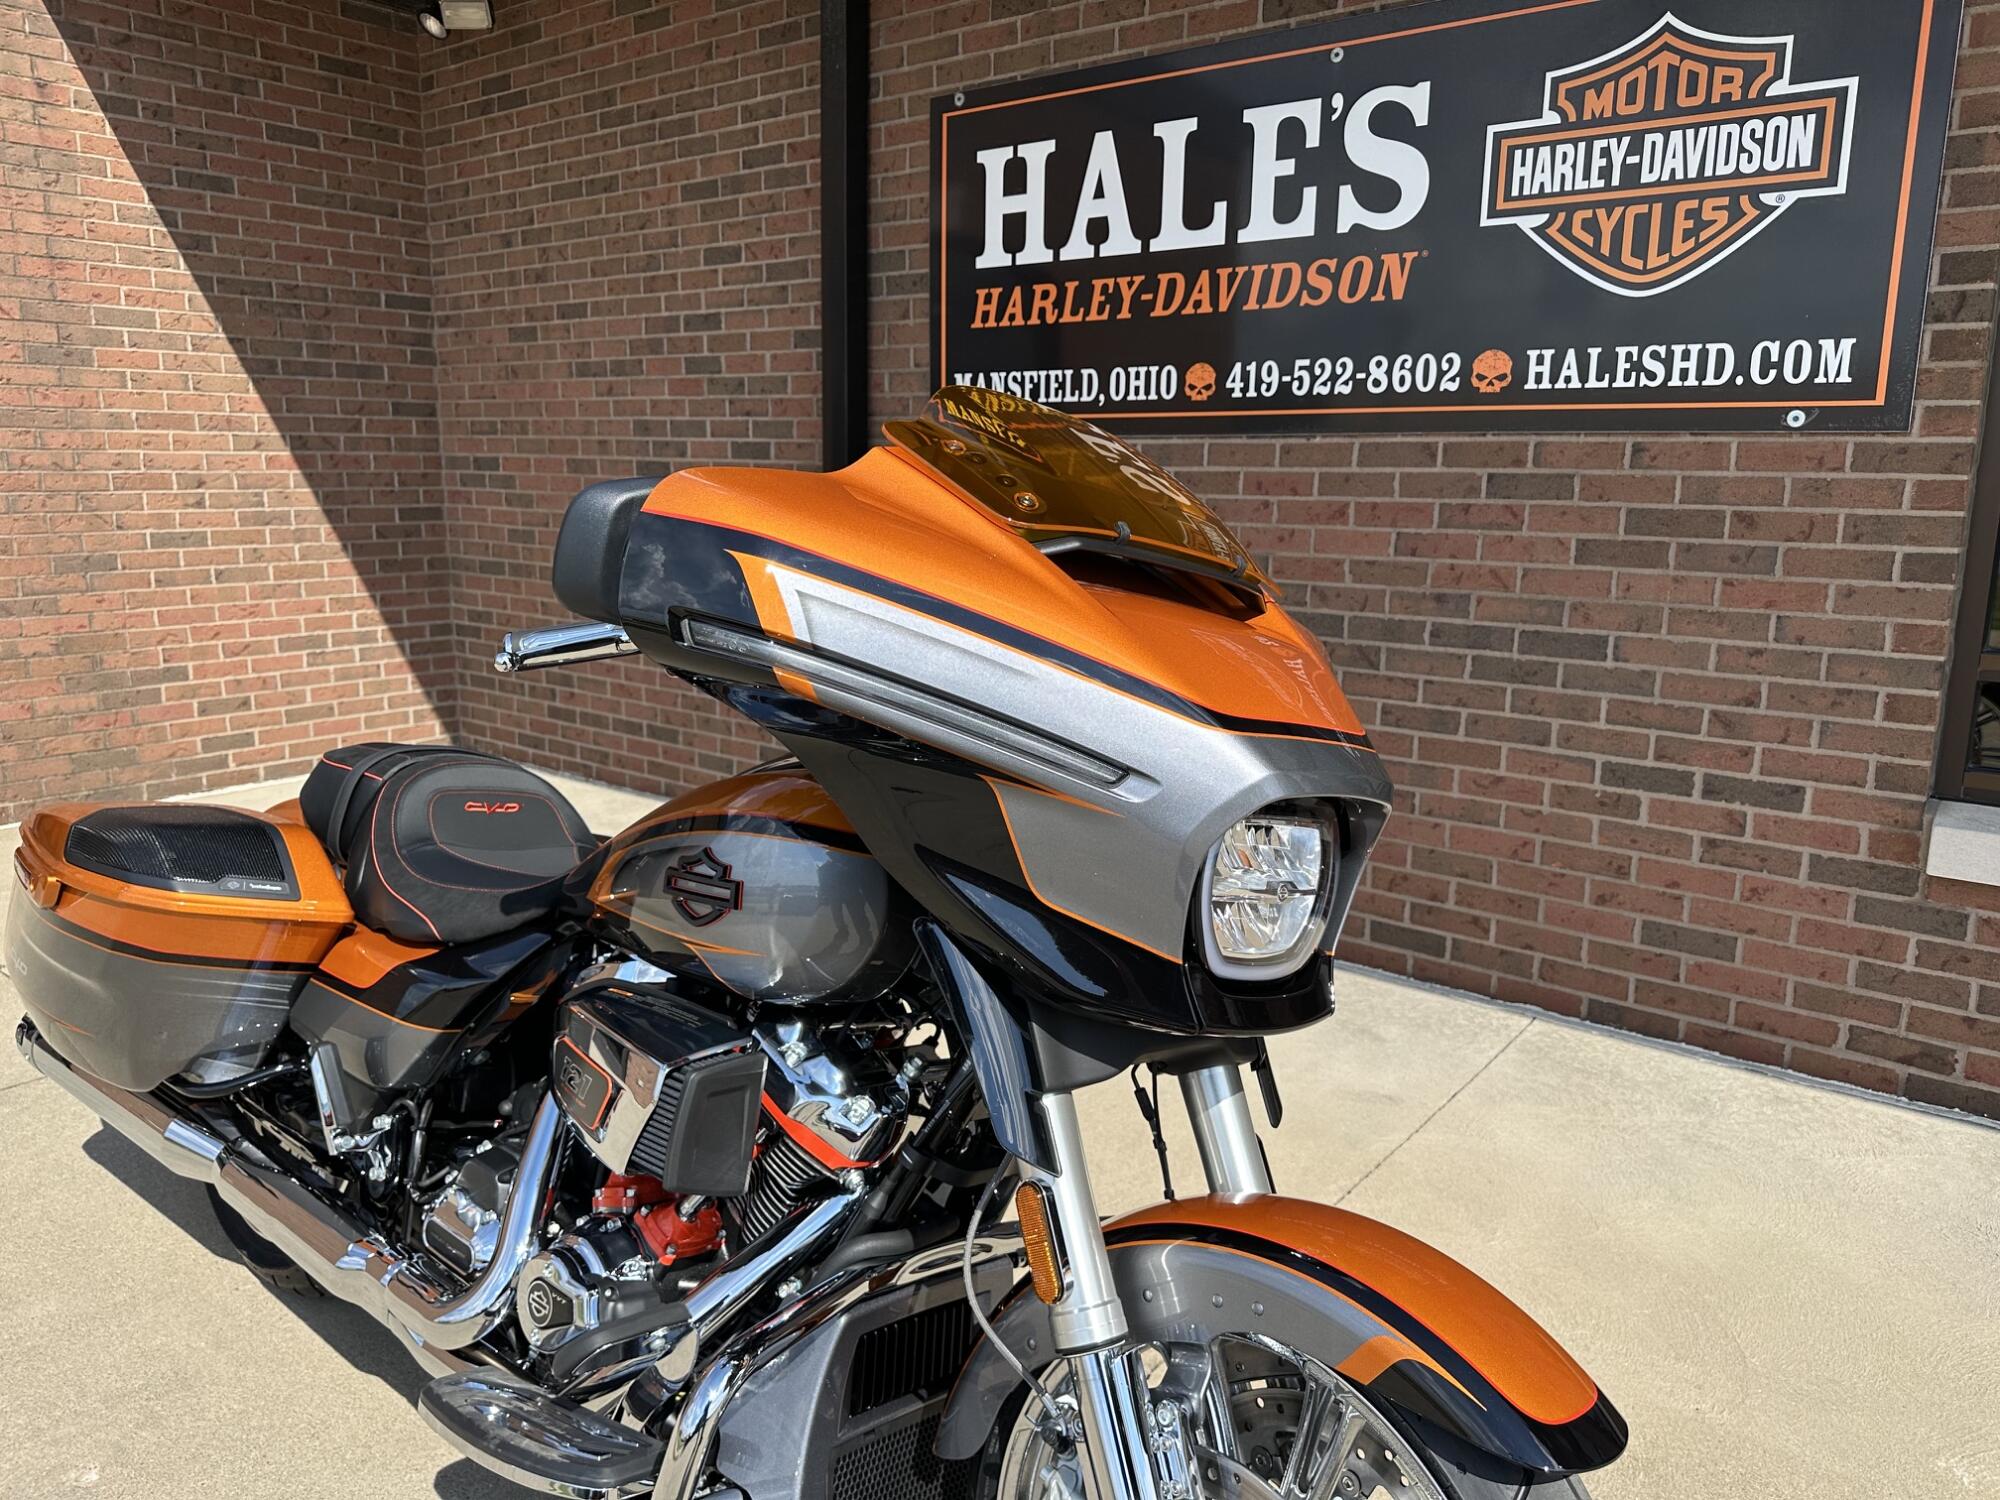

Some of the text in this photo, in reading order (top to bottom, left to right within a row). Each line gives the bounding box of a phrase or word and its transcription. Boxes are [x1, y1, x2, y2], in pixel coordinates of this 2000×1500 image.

[1582, 51, 1744, 120] MOTOR
[975, 81, 1431, 269] HALE'S
[1511, 113, 1817, 197] HARLEY-DAVIDSON
[1571, 195, 1730, 270] CYCLES
[970, 251, 1419, 329] HARLEY-DAVIDSON
[1109, 365, 1178, 400] OHIO
[1225, 352, 1462, 398] 419-522-8602
[1524, 337, 1857, 391] HALESHD.COM
[561, 1055, 593, 1100] 121
